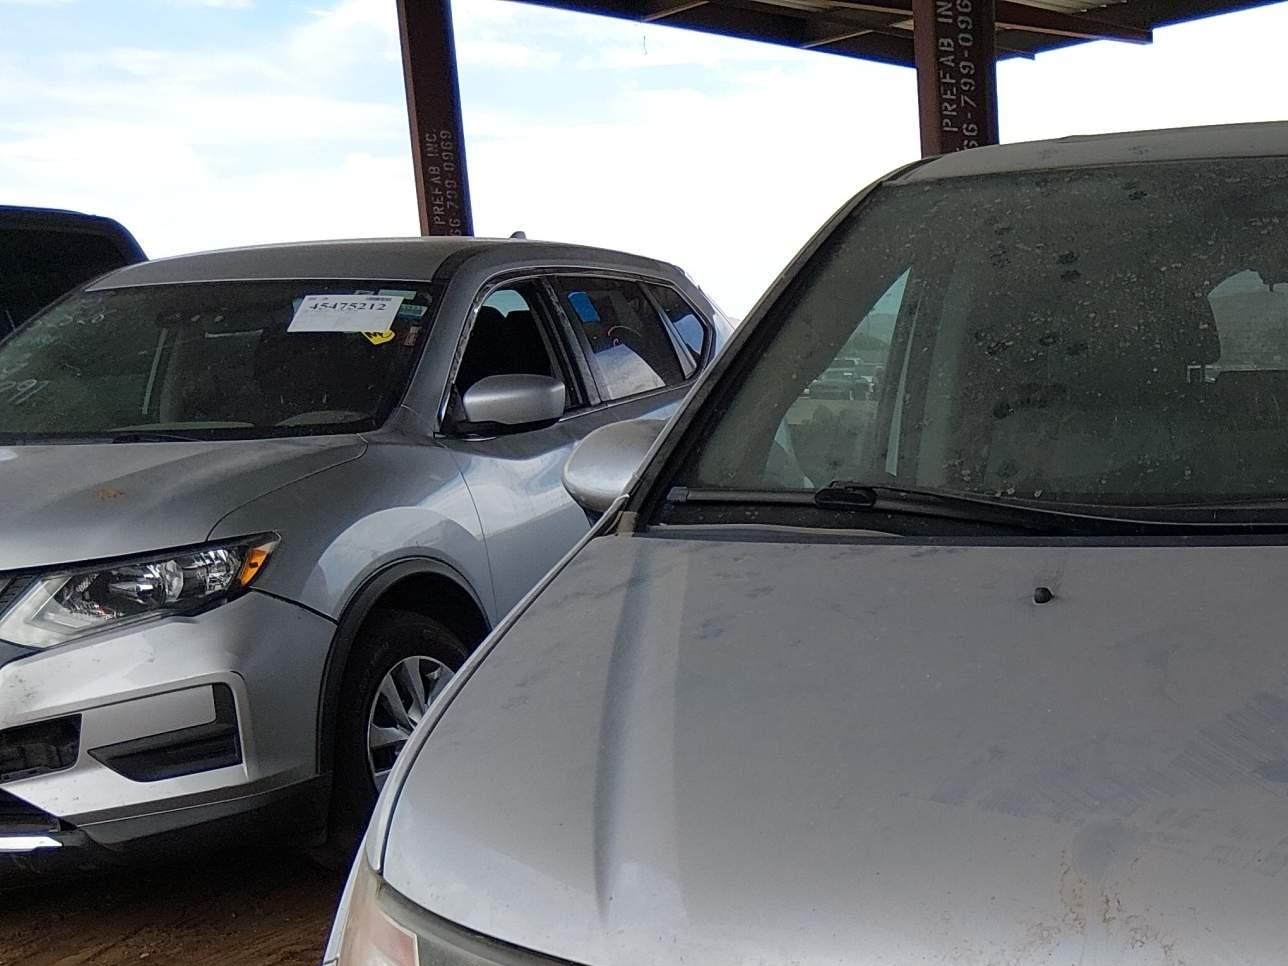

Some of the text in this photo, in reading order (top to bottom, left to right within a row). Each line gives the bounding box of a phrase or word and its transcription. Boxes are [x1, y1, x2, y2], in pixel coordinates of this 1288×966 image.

[938, 37, 959, 132] PREFAB
[428, 165, 446, 225] PREFAB
[309, 301, 387, 312] 45475212
